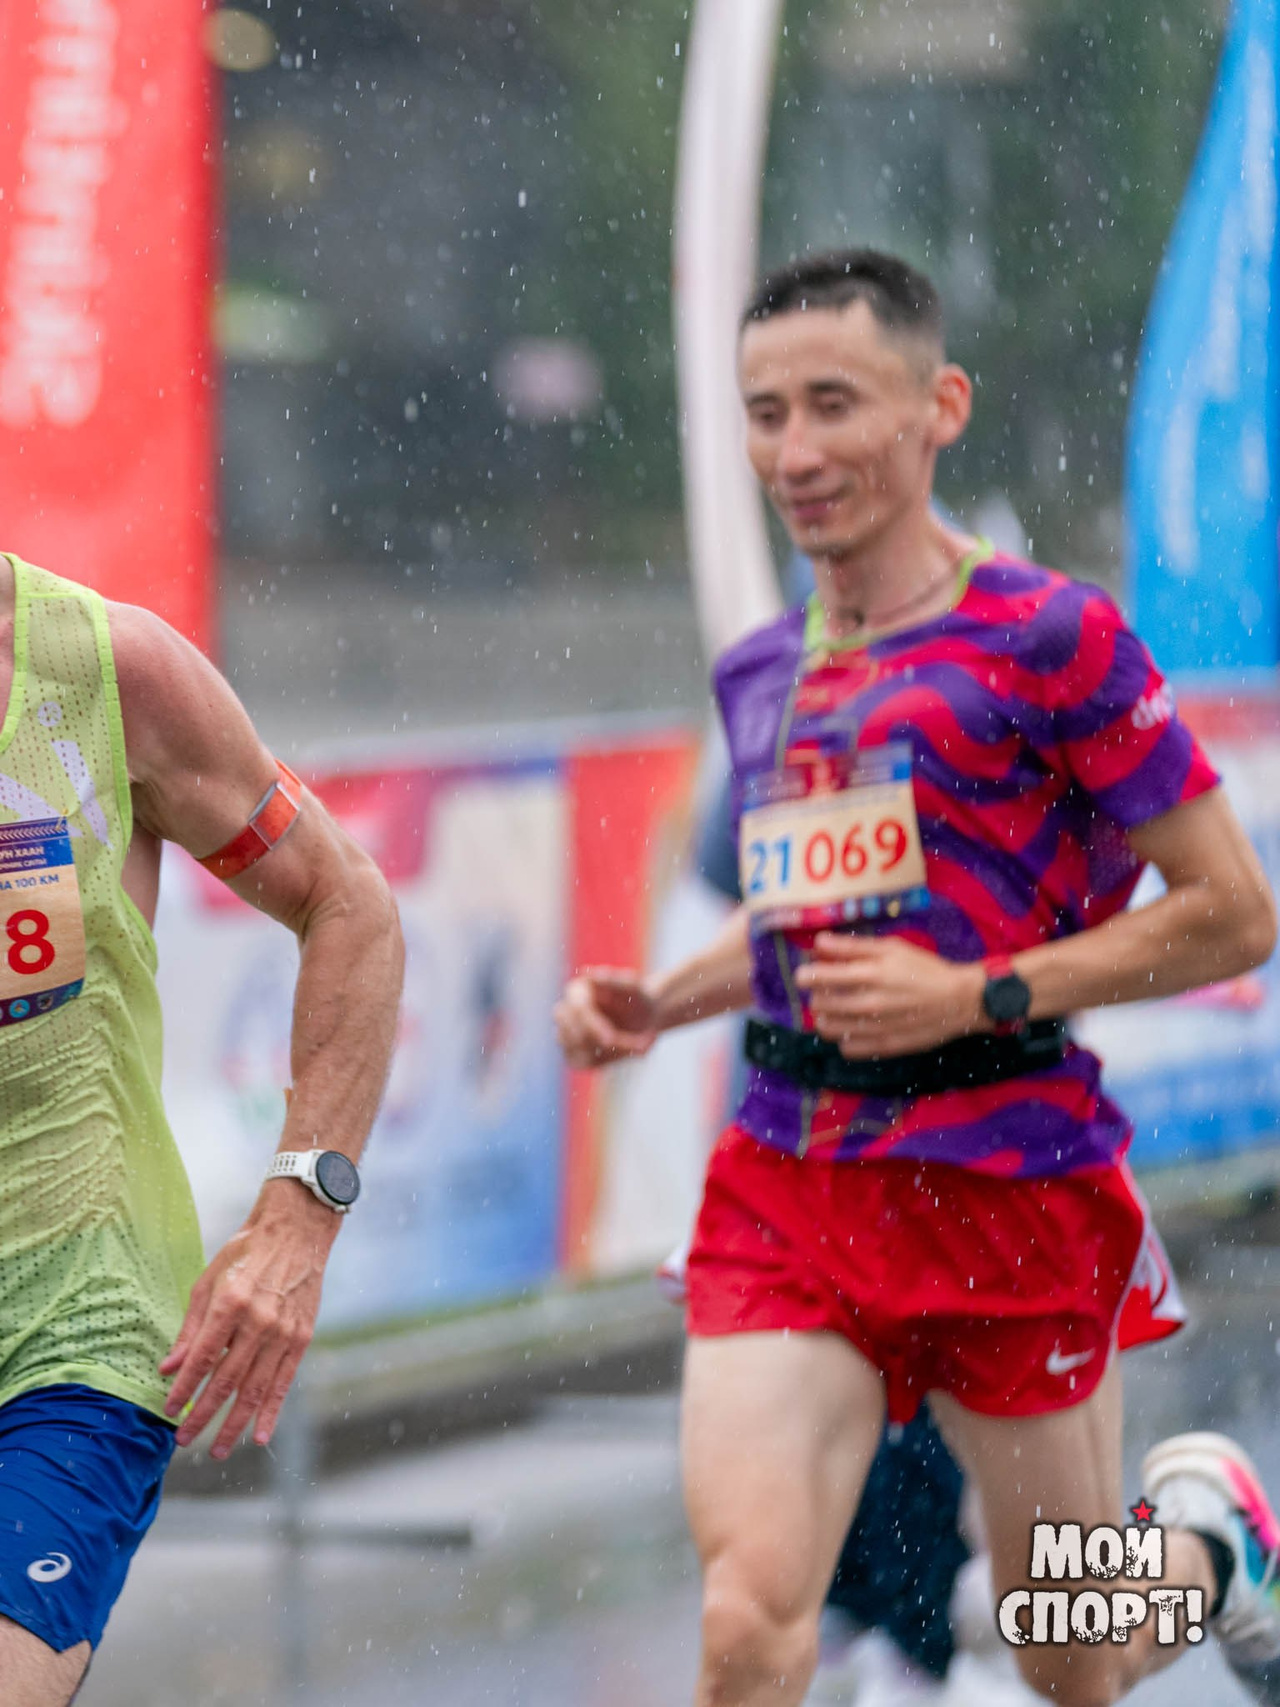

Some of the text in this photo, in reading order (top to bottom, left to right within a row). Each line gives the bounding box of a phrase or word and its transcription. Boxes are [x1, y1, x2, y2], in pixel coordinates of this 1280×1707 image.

[14, 847, 44, 857] ХААН
[15, 877, 37, 888] 100
[39, 874, 60, 884] КМ
